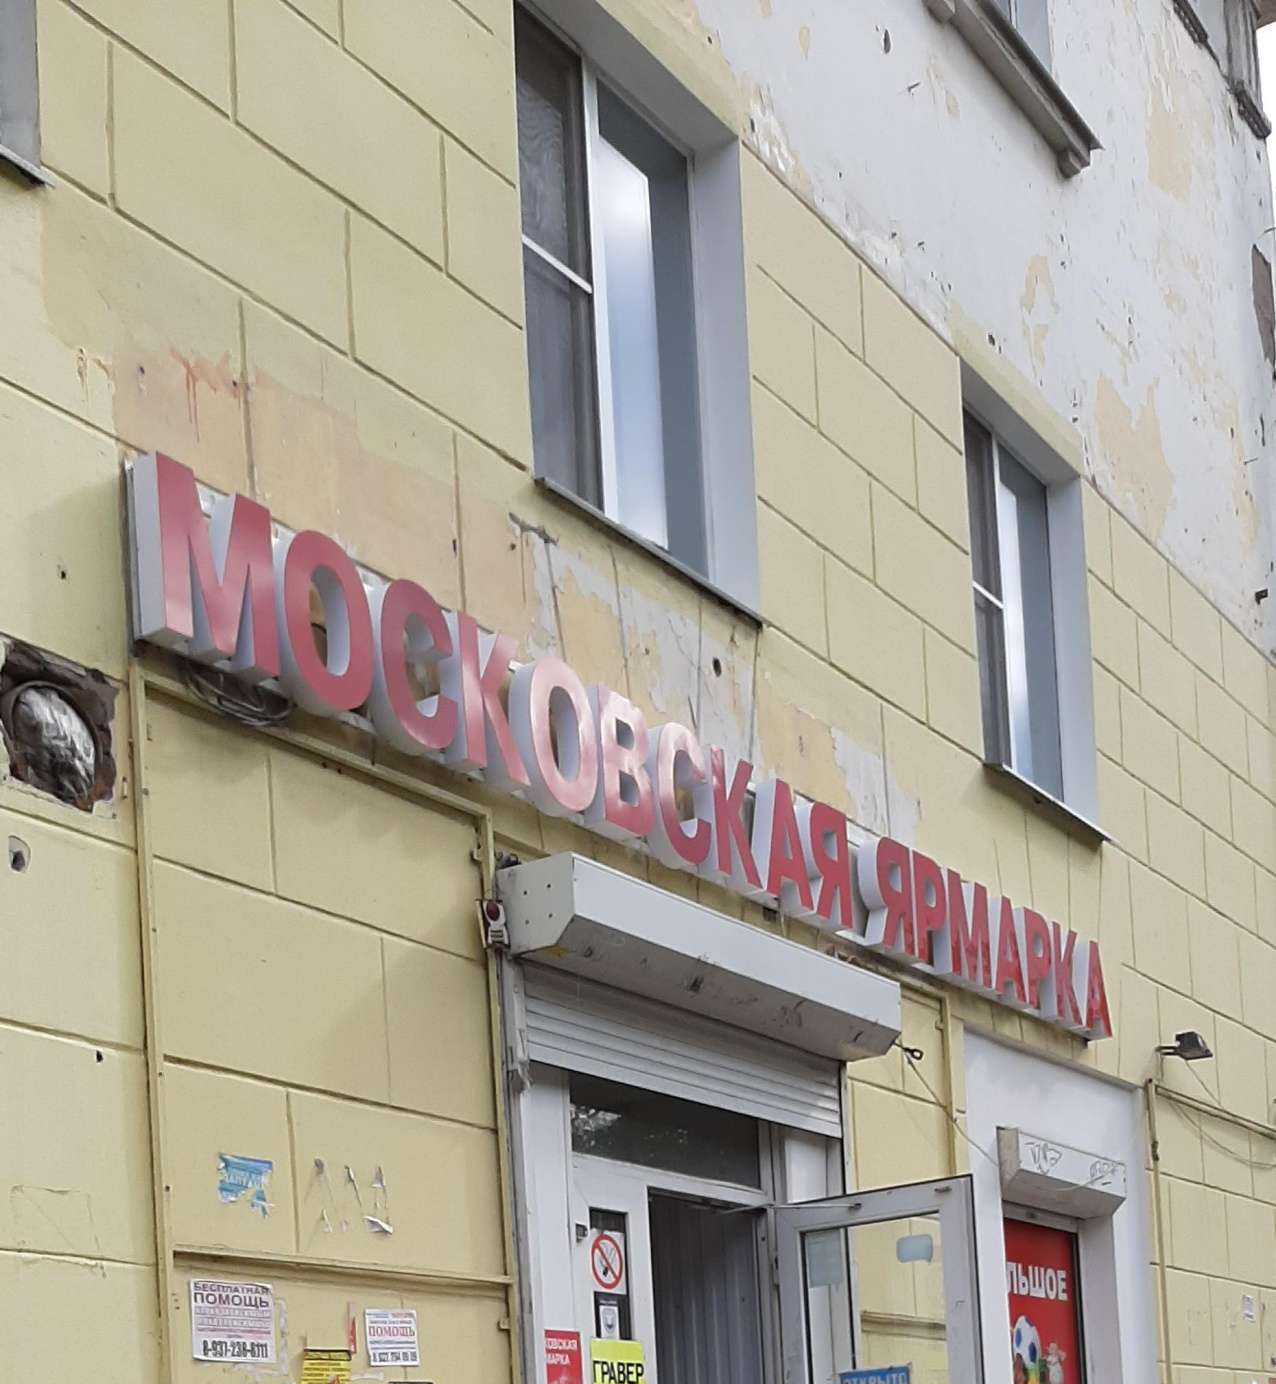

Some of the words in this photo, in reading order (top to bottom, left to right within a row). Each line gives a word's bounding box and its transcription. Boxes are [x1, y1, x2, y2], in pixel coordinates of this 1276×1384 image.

[155, 452, 852, 930] МОСКОВСКАЯ
[876, 836, 1113, 1037] ЯРМАРКА
[194, 1292, 269, 1308] ПОМОЩЬ
[369, 1326, 416, 1337] ПОМОЩЬ
[592, 1360, 645, 1384] ГРАВЕР
